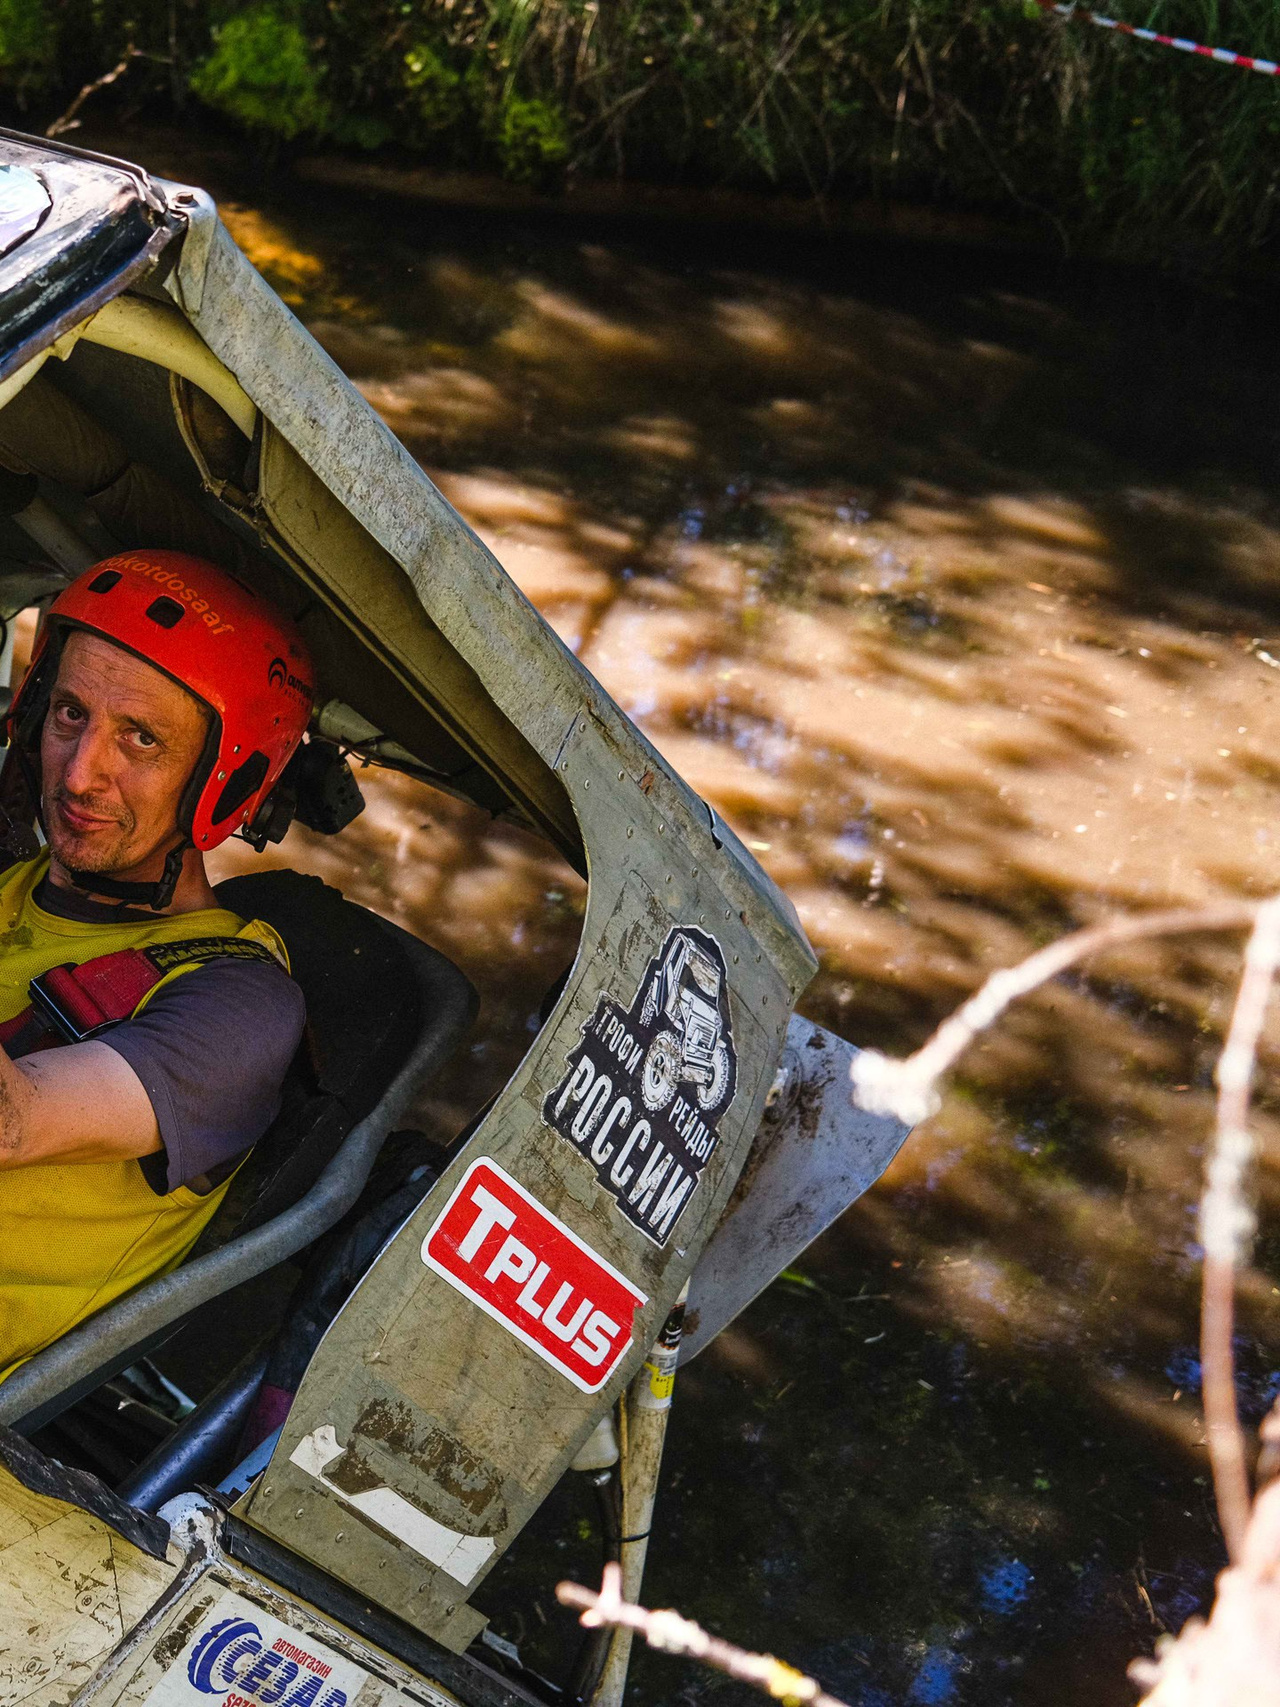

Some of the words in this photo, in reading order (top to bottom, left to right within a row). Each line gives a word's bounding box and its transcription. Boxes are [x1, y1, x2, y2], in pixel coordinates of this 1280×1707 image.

[597, 1008, 644, 1075] ТРОФИ
[554, 1054, 694, 1238] РОССИИ
[668, 1096, 718, 1164] РЕЙДЫ
[455, 1184, 622, 1367] TPLUS
[272, 1637, 333, 1679] автомагазин
